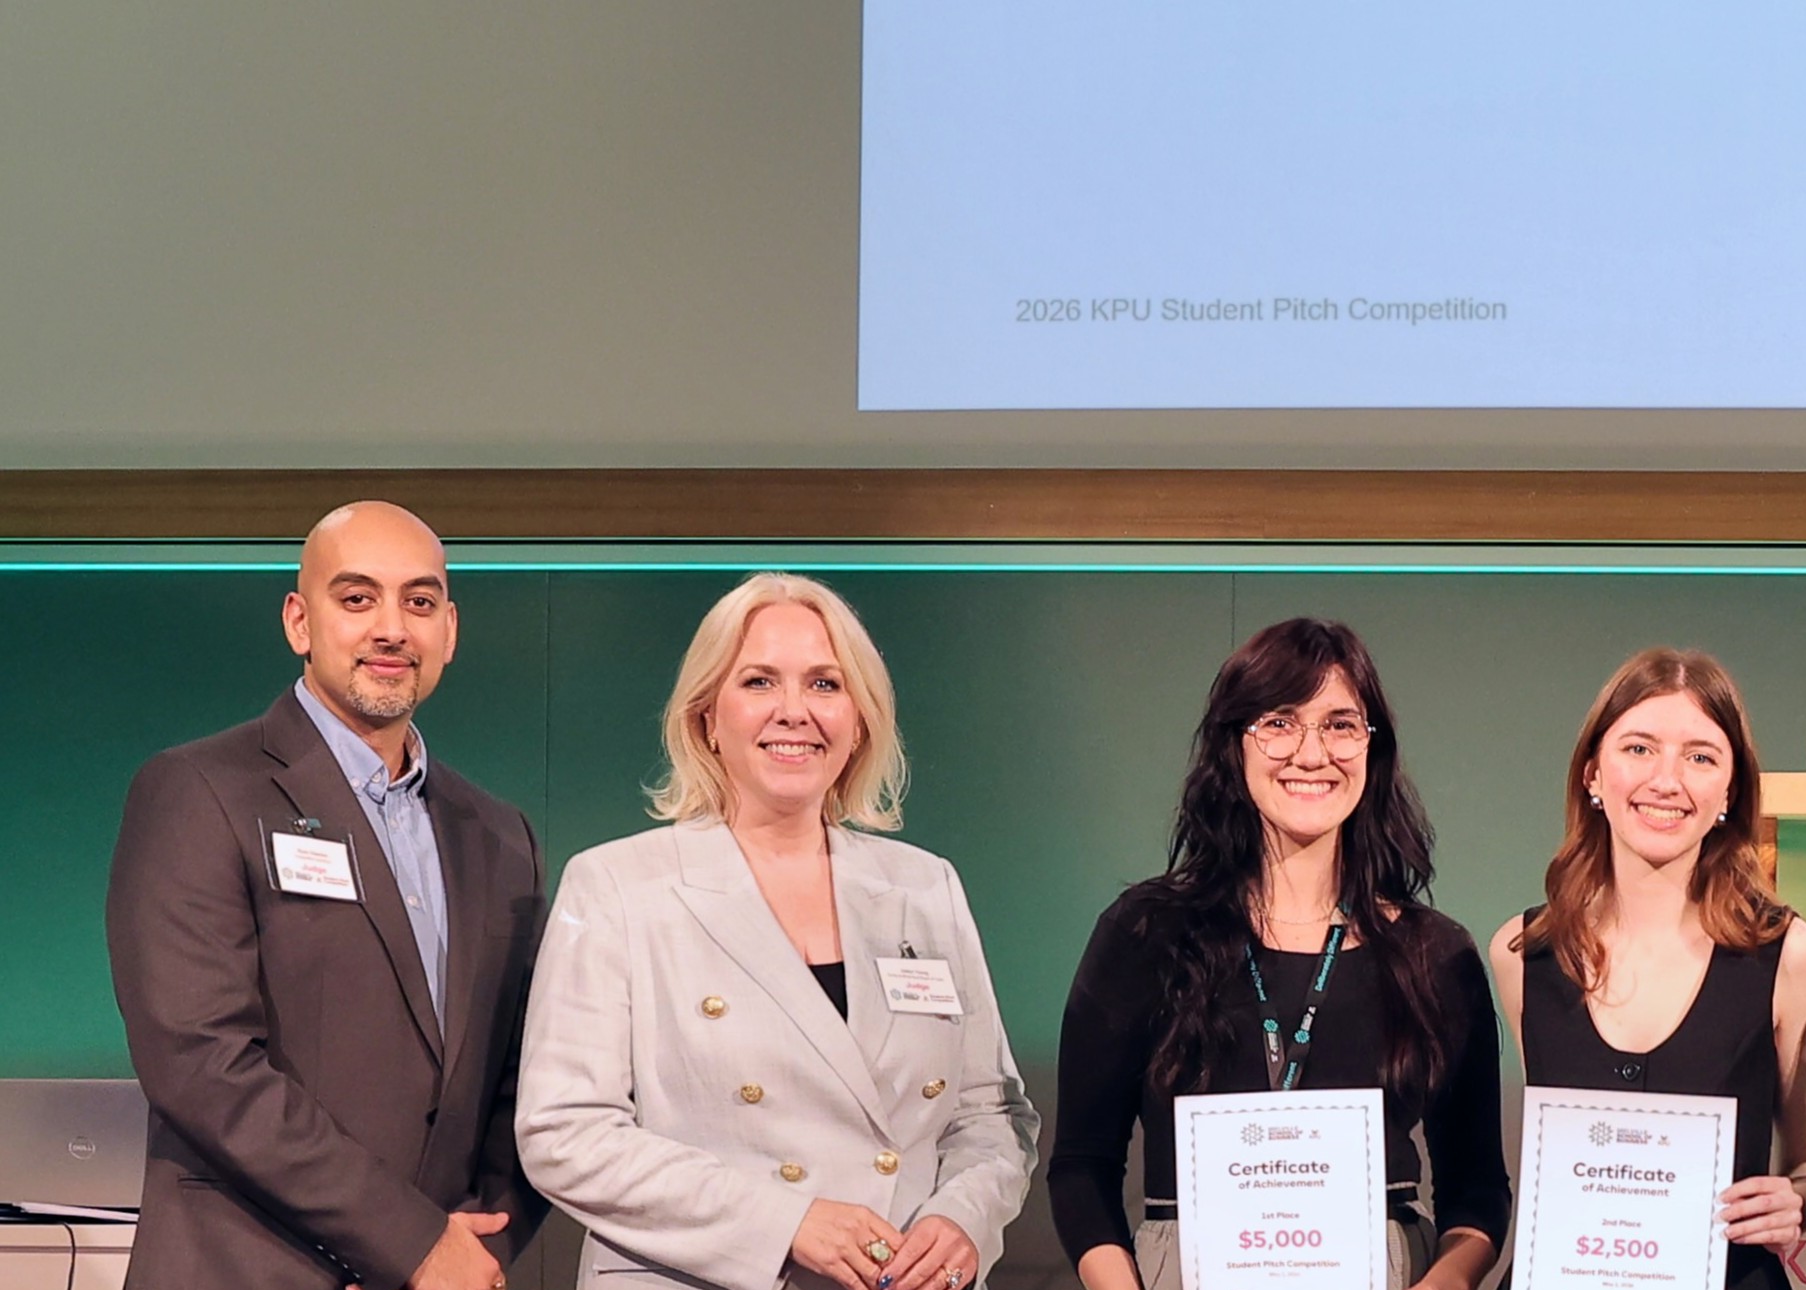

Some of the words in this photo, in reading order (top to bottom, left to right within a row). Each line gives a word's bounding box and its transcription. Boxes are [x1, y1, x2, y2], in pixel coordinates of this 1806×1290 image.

[1015, 299, 1082, 322] 2026
[1090, 299, 1151, 321] KPU
[1161, 298, 1264, 321] Student
[1273, 297, 1339, 321] Pitch
[1348, 297, 1507, 326] Competition
[1228, 1160, 1330, 1177] Certificate
[1573, 1161, 1676, 1183] Certificate
[1238, 1181, 1250, 1190] of
[1253, 1179, 1325, 1189] Achievement
[1582, 1182, 1594, 1192] of
[1596, 1183, 1670, 1197] Achievement
[1276, 1211, 1300, 1219] Place
[1619, 1219, 1642, 1228] Place
[1239, 1229, 1322, 1251] $5,000
[1576, 1234, 1659, 1259] $2,500
[1226, 1261, 1261, 1269] Student
[1263, 1260, 1285, 1268] Pitch
[1286, 1259, 1340, 1269] Competition
[1561, 1266, 1596, 1276] Student
[1597, 1269, 1620, 1278] Pitch
[1621, 1271, 1676, 1282] Competition
